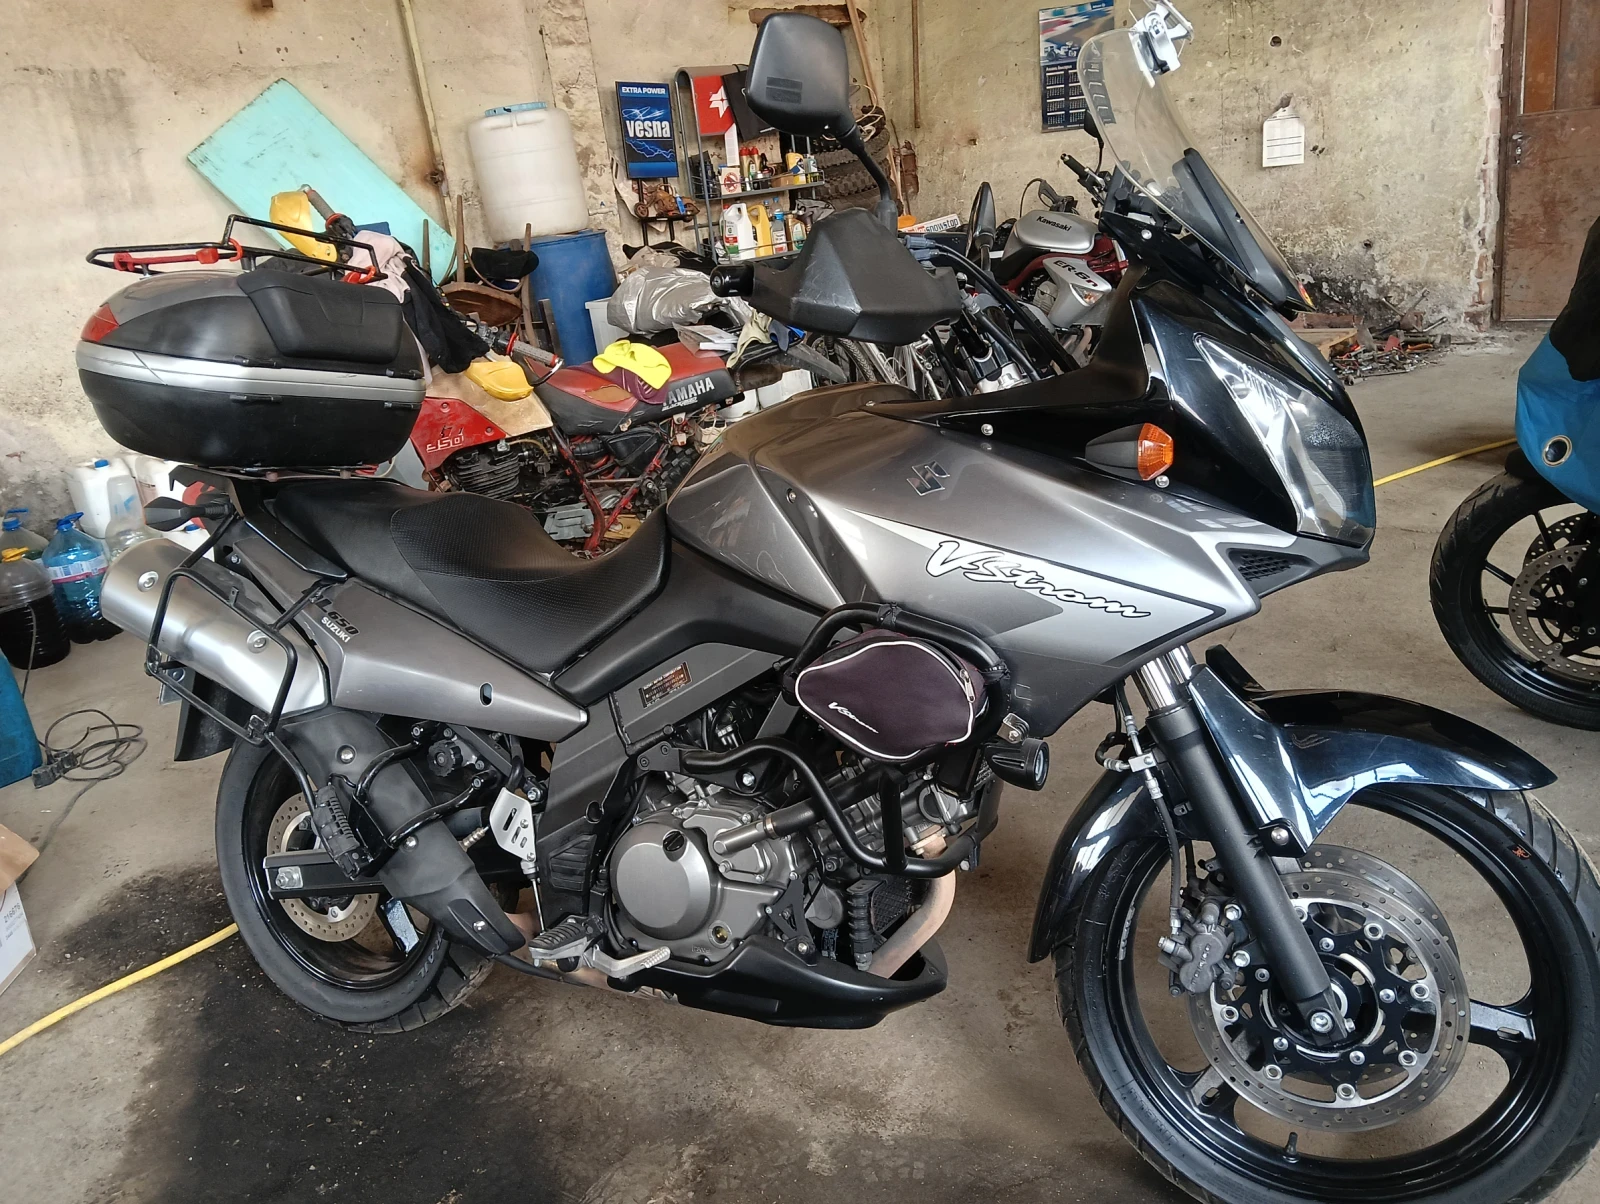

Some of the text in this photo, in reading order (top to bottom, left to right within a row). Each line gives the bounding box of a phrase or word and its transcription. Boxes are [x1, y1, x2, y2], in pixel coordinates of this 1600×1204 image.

[621, 86, 666, 95] EXTRA POWER
[625, 120, 671, 138] vesna
[1036, 215, 1072, 232] Kawasaki
[1053, 259, 1099, 288] ER-6n
[664, 376, 715, 406] AMAHA
[314, 595, 359, 635] L650
[321, 616, 351, 643] SUZUKI
